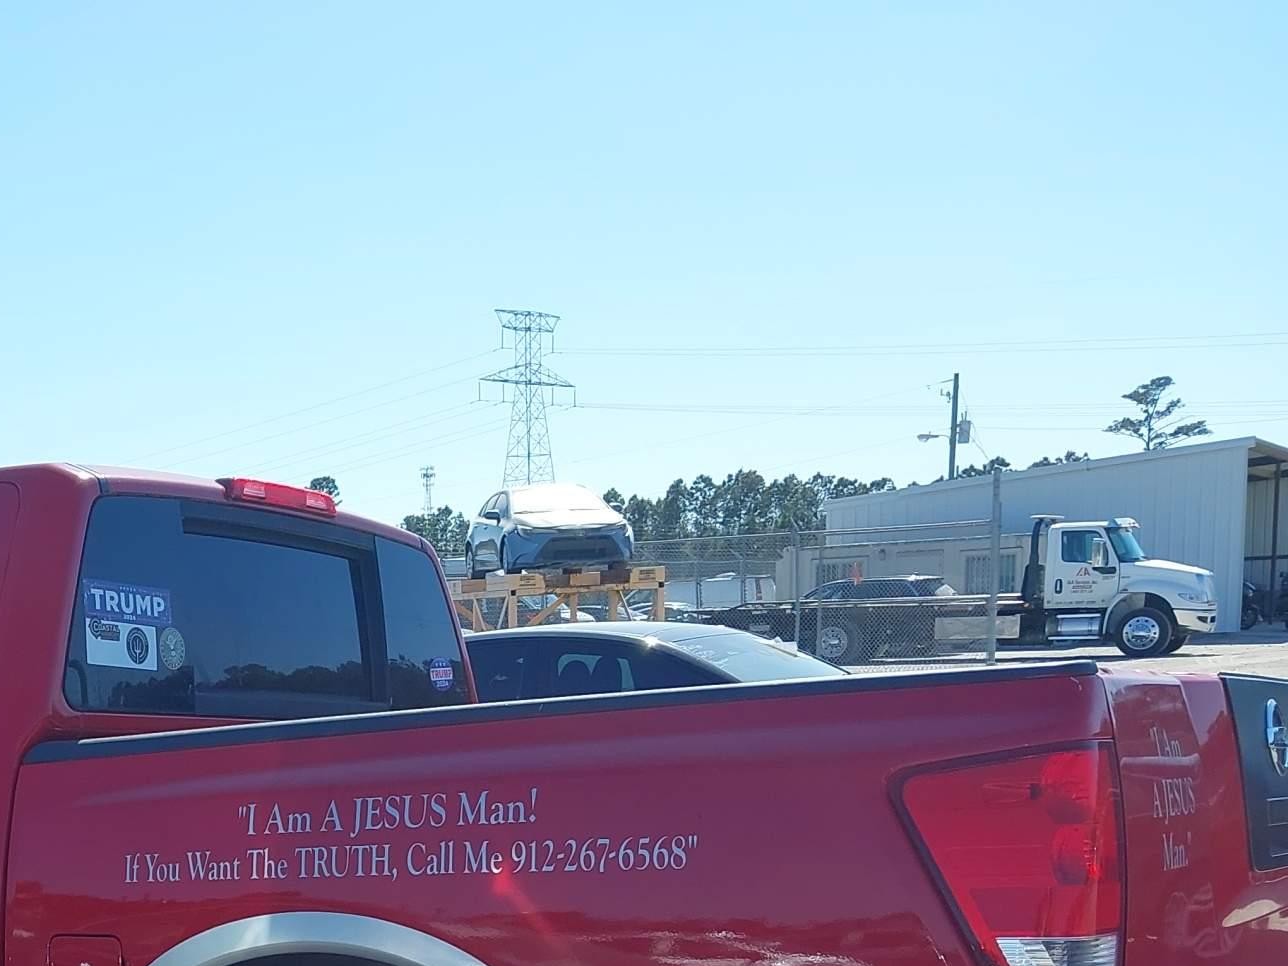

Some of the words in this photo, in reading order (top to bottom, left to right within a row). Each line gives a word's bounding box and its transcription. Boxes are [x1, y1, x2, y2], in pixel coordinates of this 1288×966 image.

[90, 587, 165, 617] TRUMP
[431, 669, 452, 680] TRUMP
[1162, 728, 1183, 758] Am
[237, 803, 257, 836] "I
[263, 802, 312, 835] Am
[319, 799, 344, 832] A
[349, 792, 448, 838] JESUS
[456, 787, 538, 826] Man!
[1152, 782, 1162, 818] A
[1162, 776, 1196, 825] JESUS
[124, 854, 140, 883] If
[144, 853, 181, 883] You
[186, 851, 241, 881] Want
[246, 847, 289, 881] The
[294, 842, 399, 882] TRUTH,
[406, 840, 456, 876] Call
[463, 840, 503, 875] Me
[511, 834, 699, 874] 912-267-6568"
